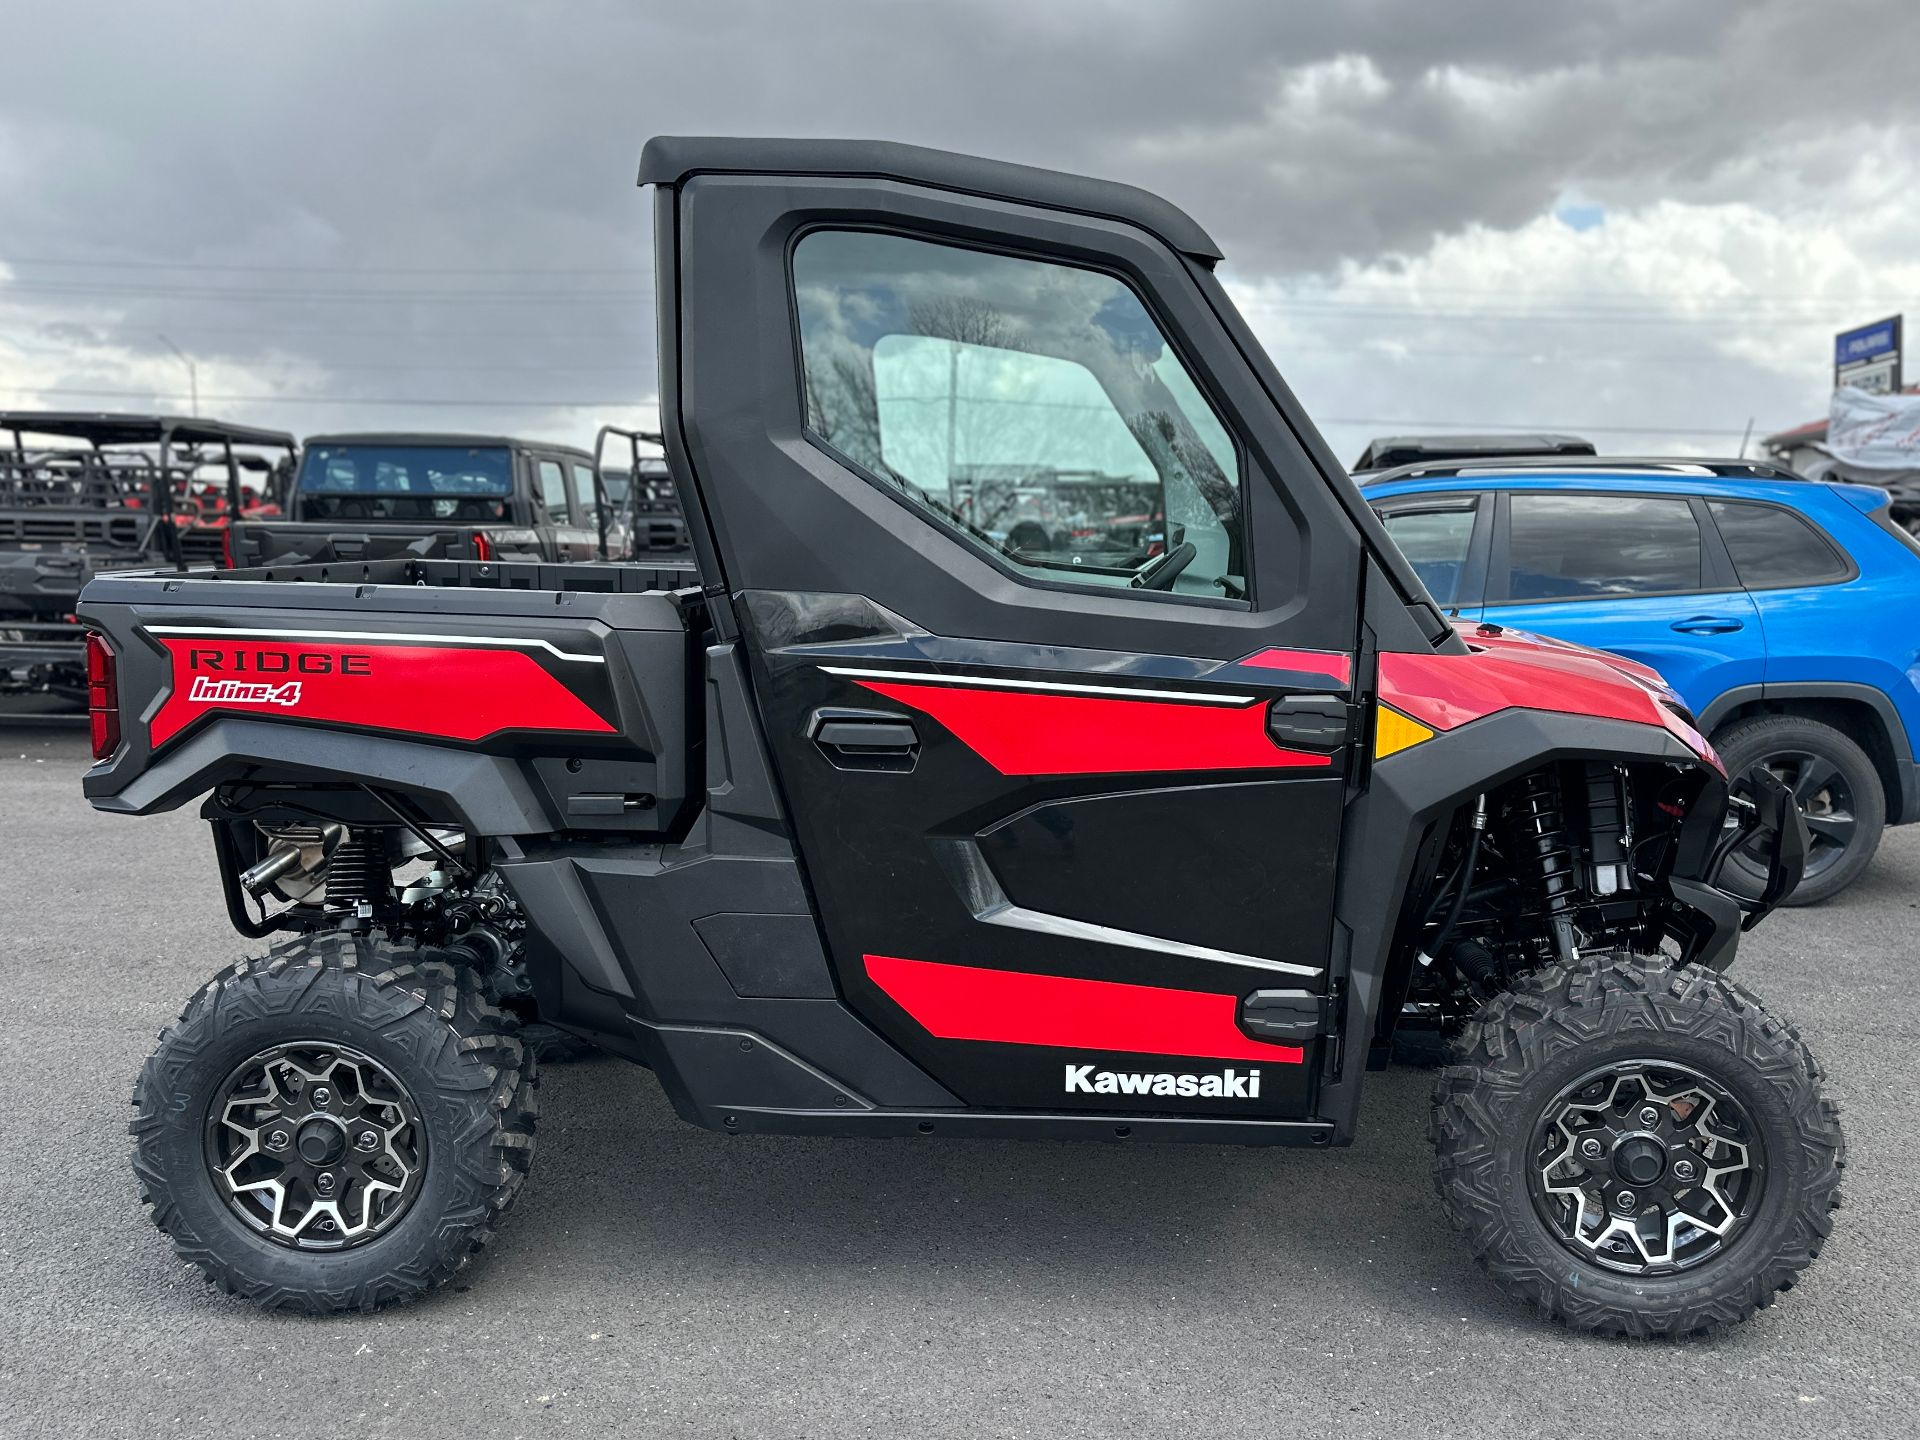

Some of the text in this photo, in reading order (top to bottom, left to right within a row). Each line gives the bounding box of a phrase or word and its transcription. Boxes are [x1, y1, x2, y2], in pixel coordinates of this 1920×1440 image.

[190, 649, 372, 676] RIDGE
[188, 676, 303, 706] Inline-4
[1065, 1064, 1261, 1098] Kawasaki
[1500, 1172, 1550, 1258] DURO
[1568, 1271, 1580, 1288] 4
